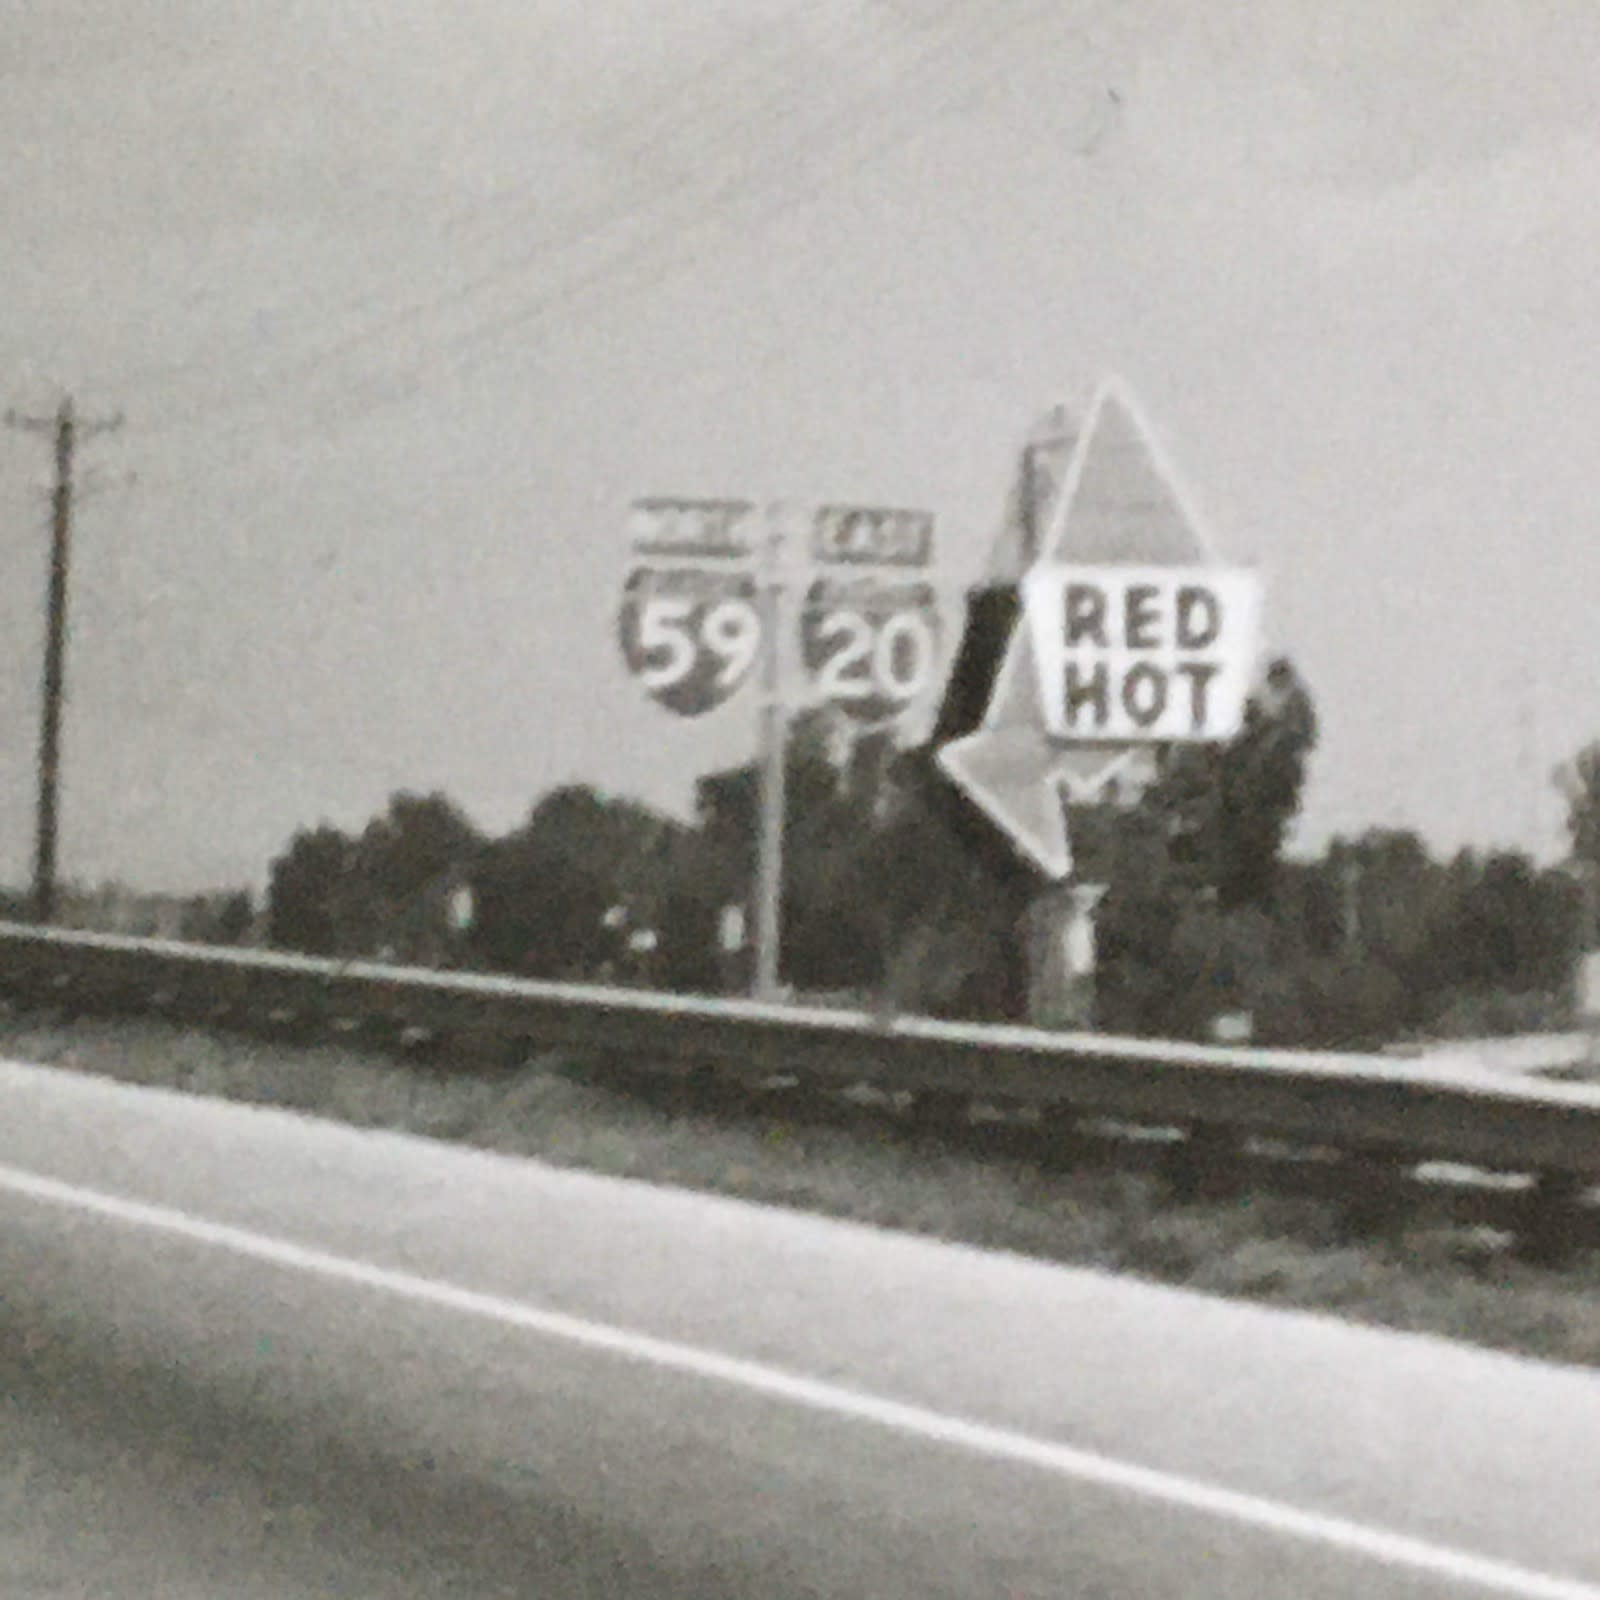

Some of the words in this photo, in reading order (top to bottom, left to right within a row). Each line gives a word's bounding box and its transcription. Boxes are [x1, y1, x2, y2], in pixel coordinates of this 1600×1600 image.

[639, 599, 761, 689] 59
[820, 611, 932, 698] 20
[1065, 583, 1221, 649] RED
[1065, 660, 1221, 728] HOT
